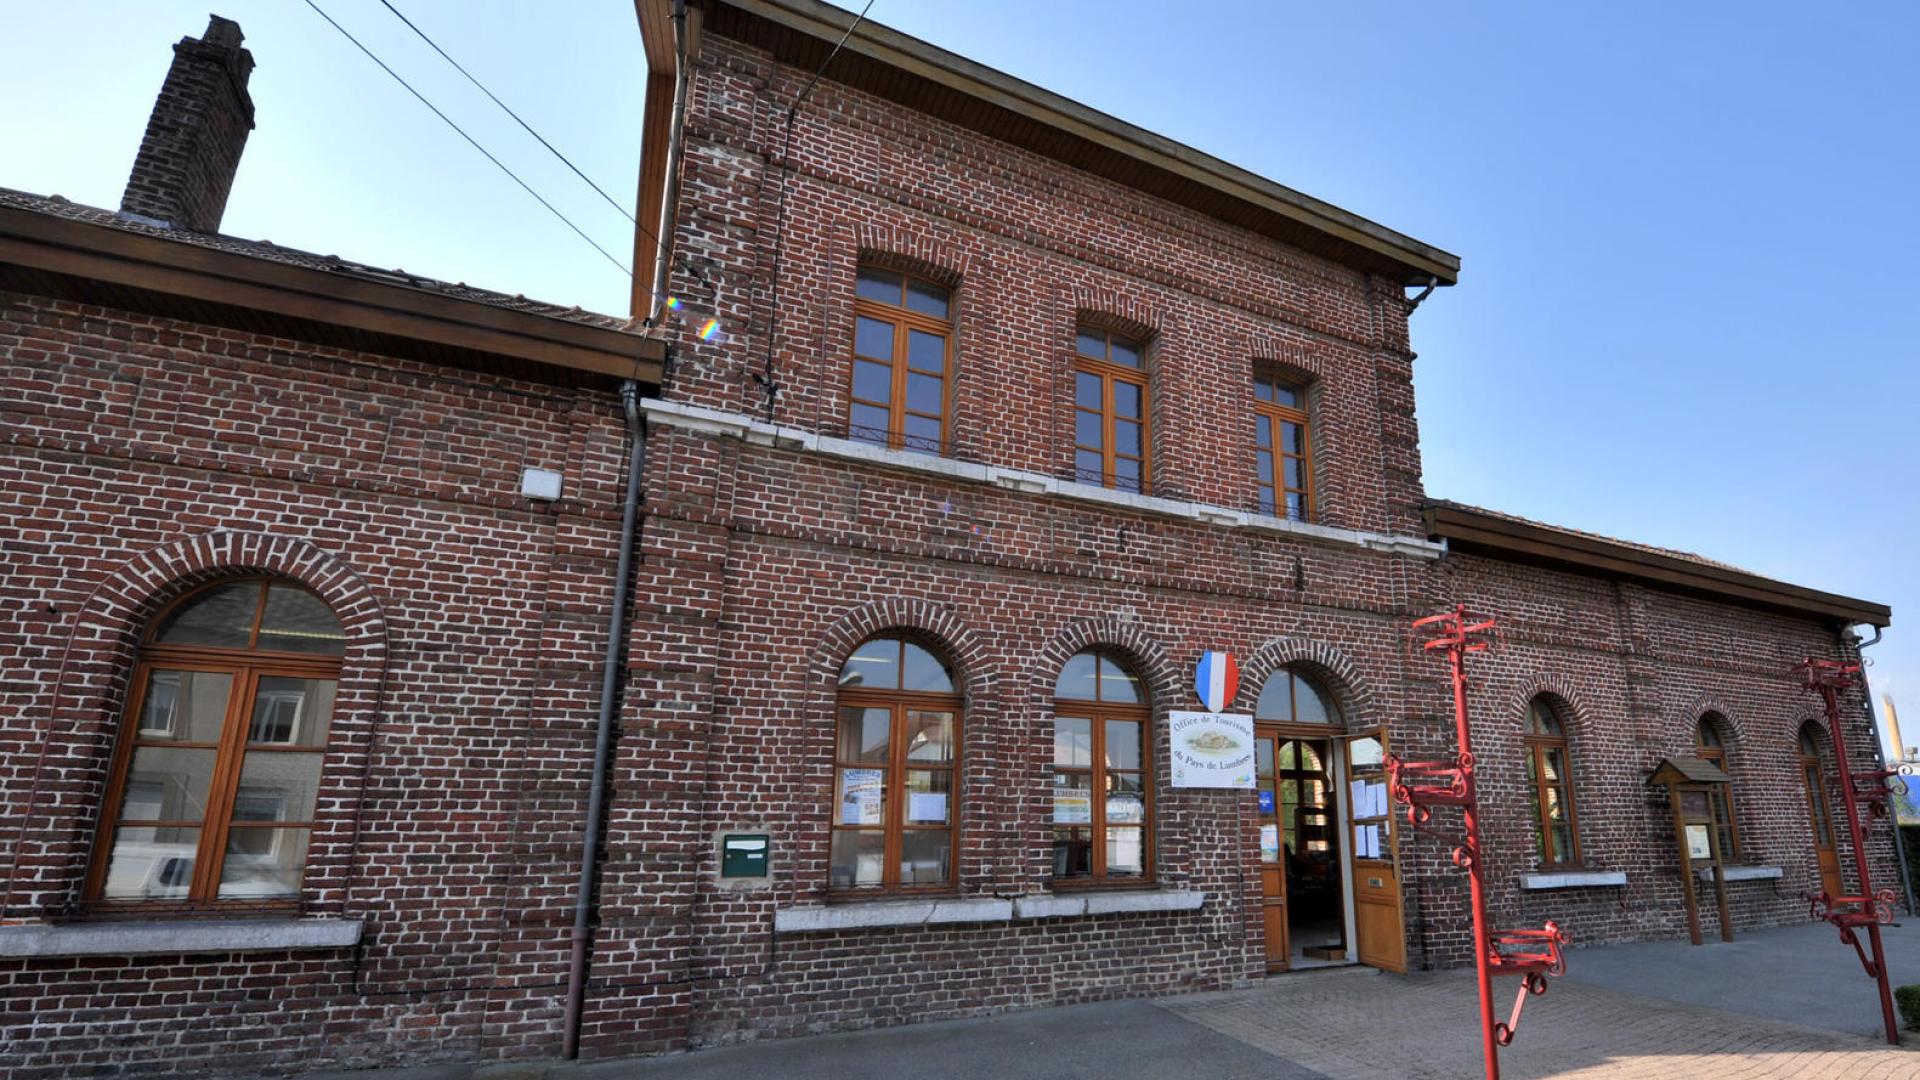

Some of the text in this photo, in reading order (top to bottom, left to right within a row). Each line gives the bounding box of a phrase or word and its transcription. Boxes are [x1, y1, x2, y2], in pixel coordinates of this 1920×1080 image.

[1173, 715, 1251, 736] Office de Tourisme
[1185, 755, 1204, 769] Pays
[1207, 761, 1217, 770] de
